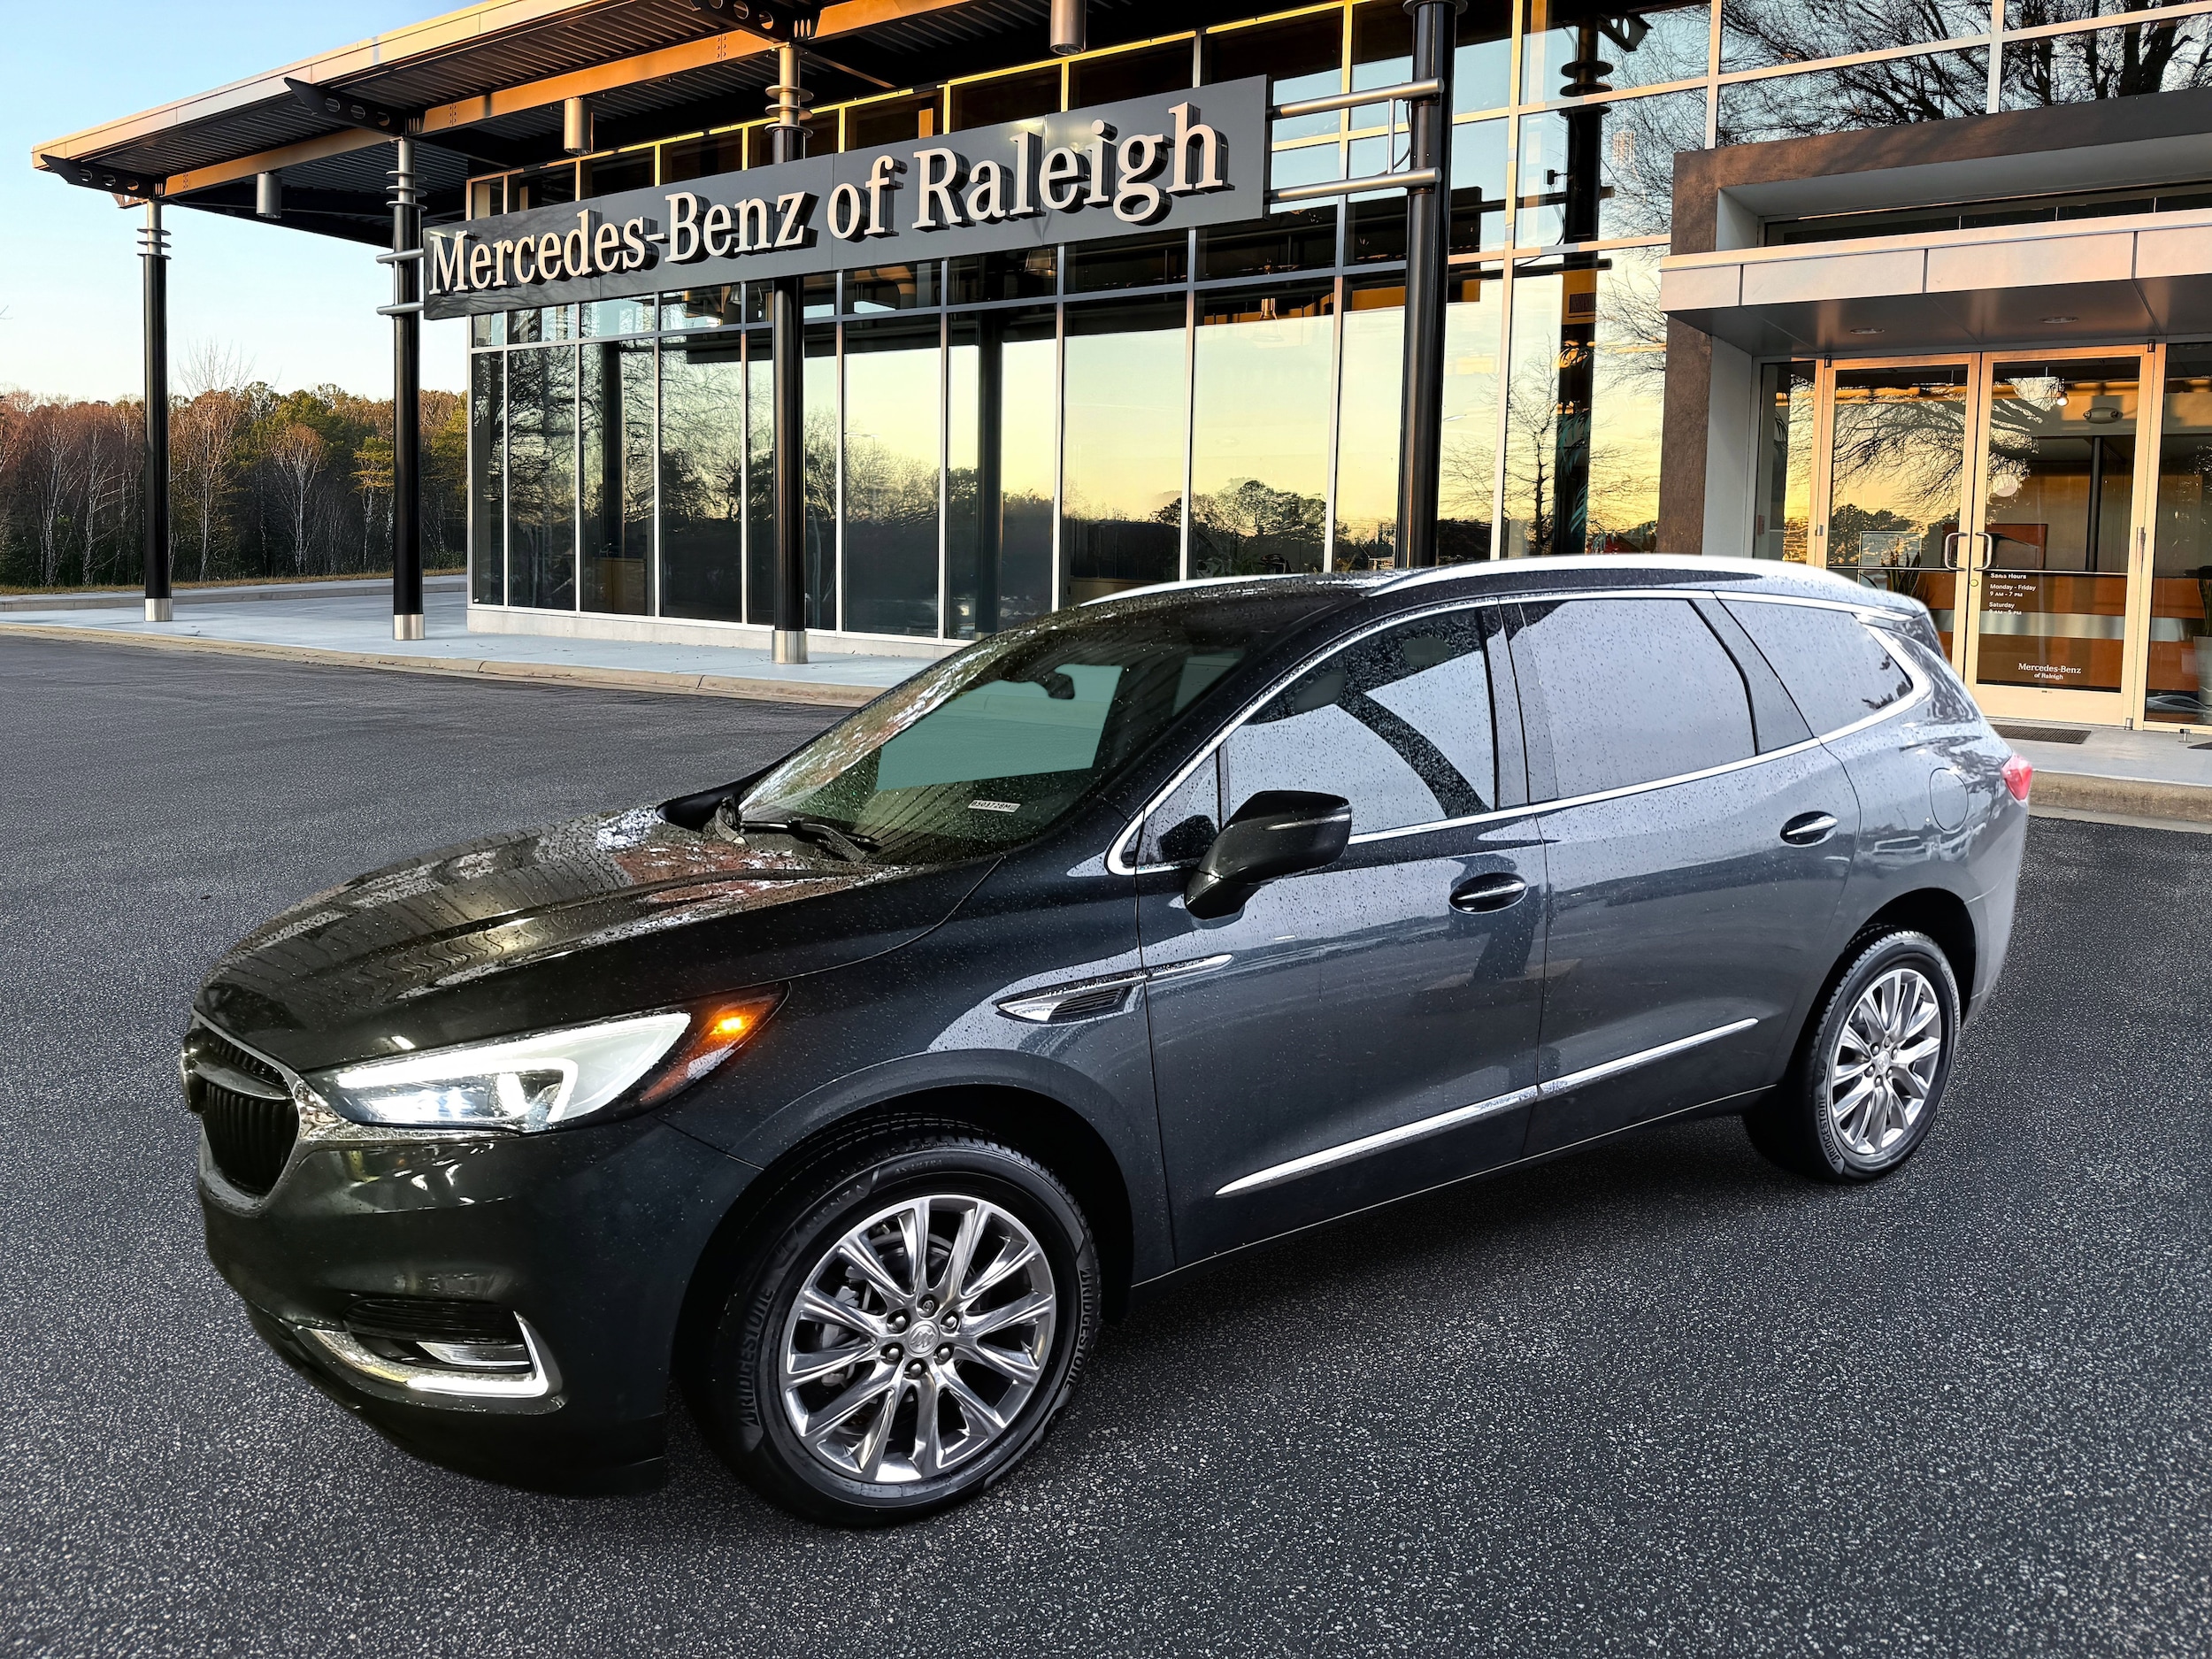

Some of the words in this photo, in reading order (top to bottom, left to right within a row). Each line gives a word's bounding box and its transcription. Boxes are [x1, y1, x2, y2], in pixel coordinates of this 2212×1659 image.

[428, 190, 810, 296] Mercedes-Benz
[826, 154, 895, 241] of
[912, 102, 1225, 231] Raleigh
[2017, 662, 2082, 674] Mercedes-Benz
[1064, 1265, 1094, 1391] BRIDGESTONE
